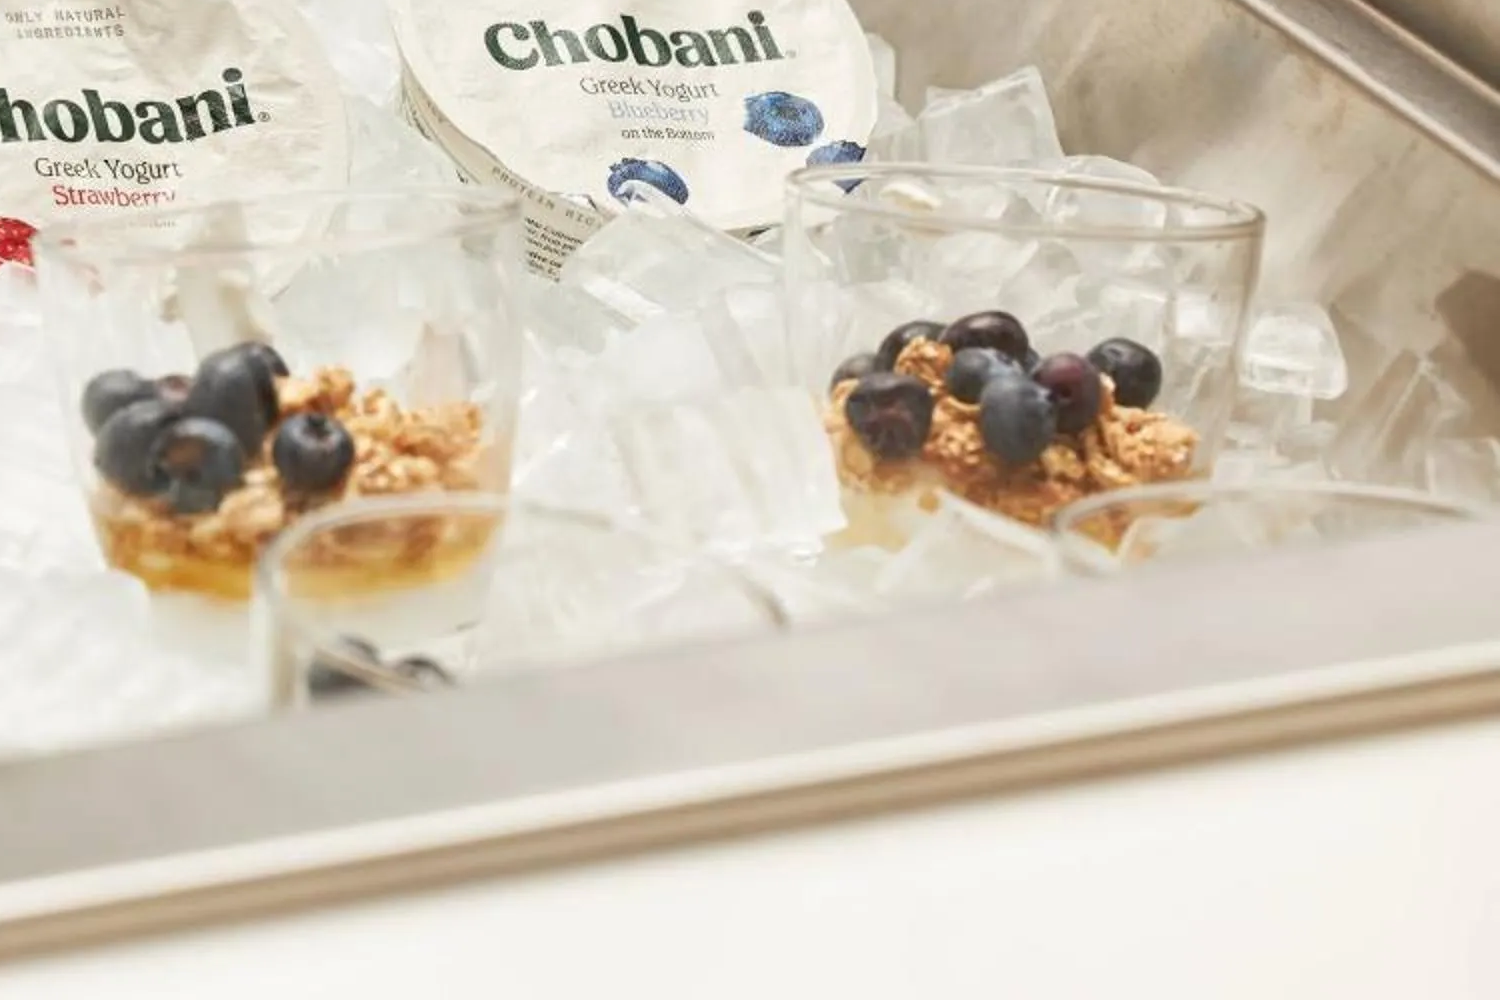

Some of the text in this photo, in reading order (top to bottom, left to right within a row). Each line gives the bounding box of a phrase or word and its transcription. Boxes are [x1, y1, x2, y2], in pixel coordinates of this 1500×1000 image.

[4, 5, 127, 24] ONLY NATURAL
[16, 24, 126, 40] INGREDIENTS
[484, 10, 785, 72] Chobani
[579, 75, 720, 103] Greek Yogurt
[607, 99, 710, 126] Blueberry
[620, 127, 716, 141] on the Bottom
[34, 157, 184, 185] Greek Yogurt
